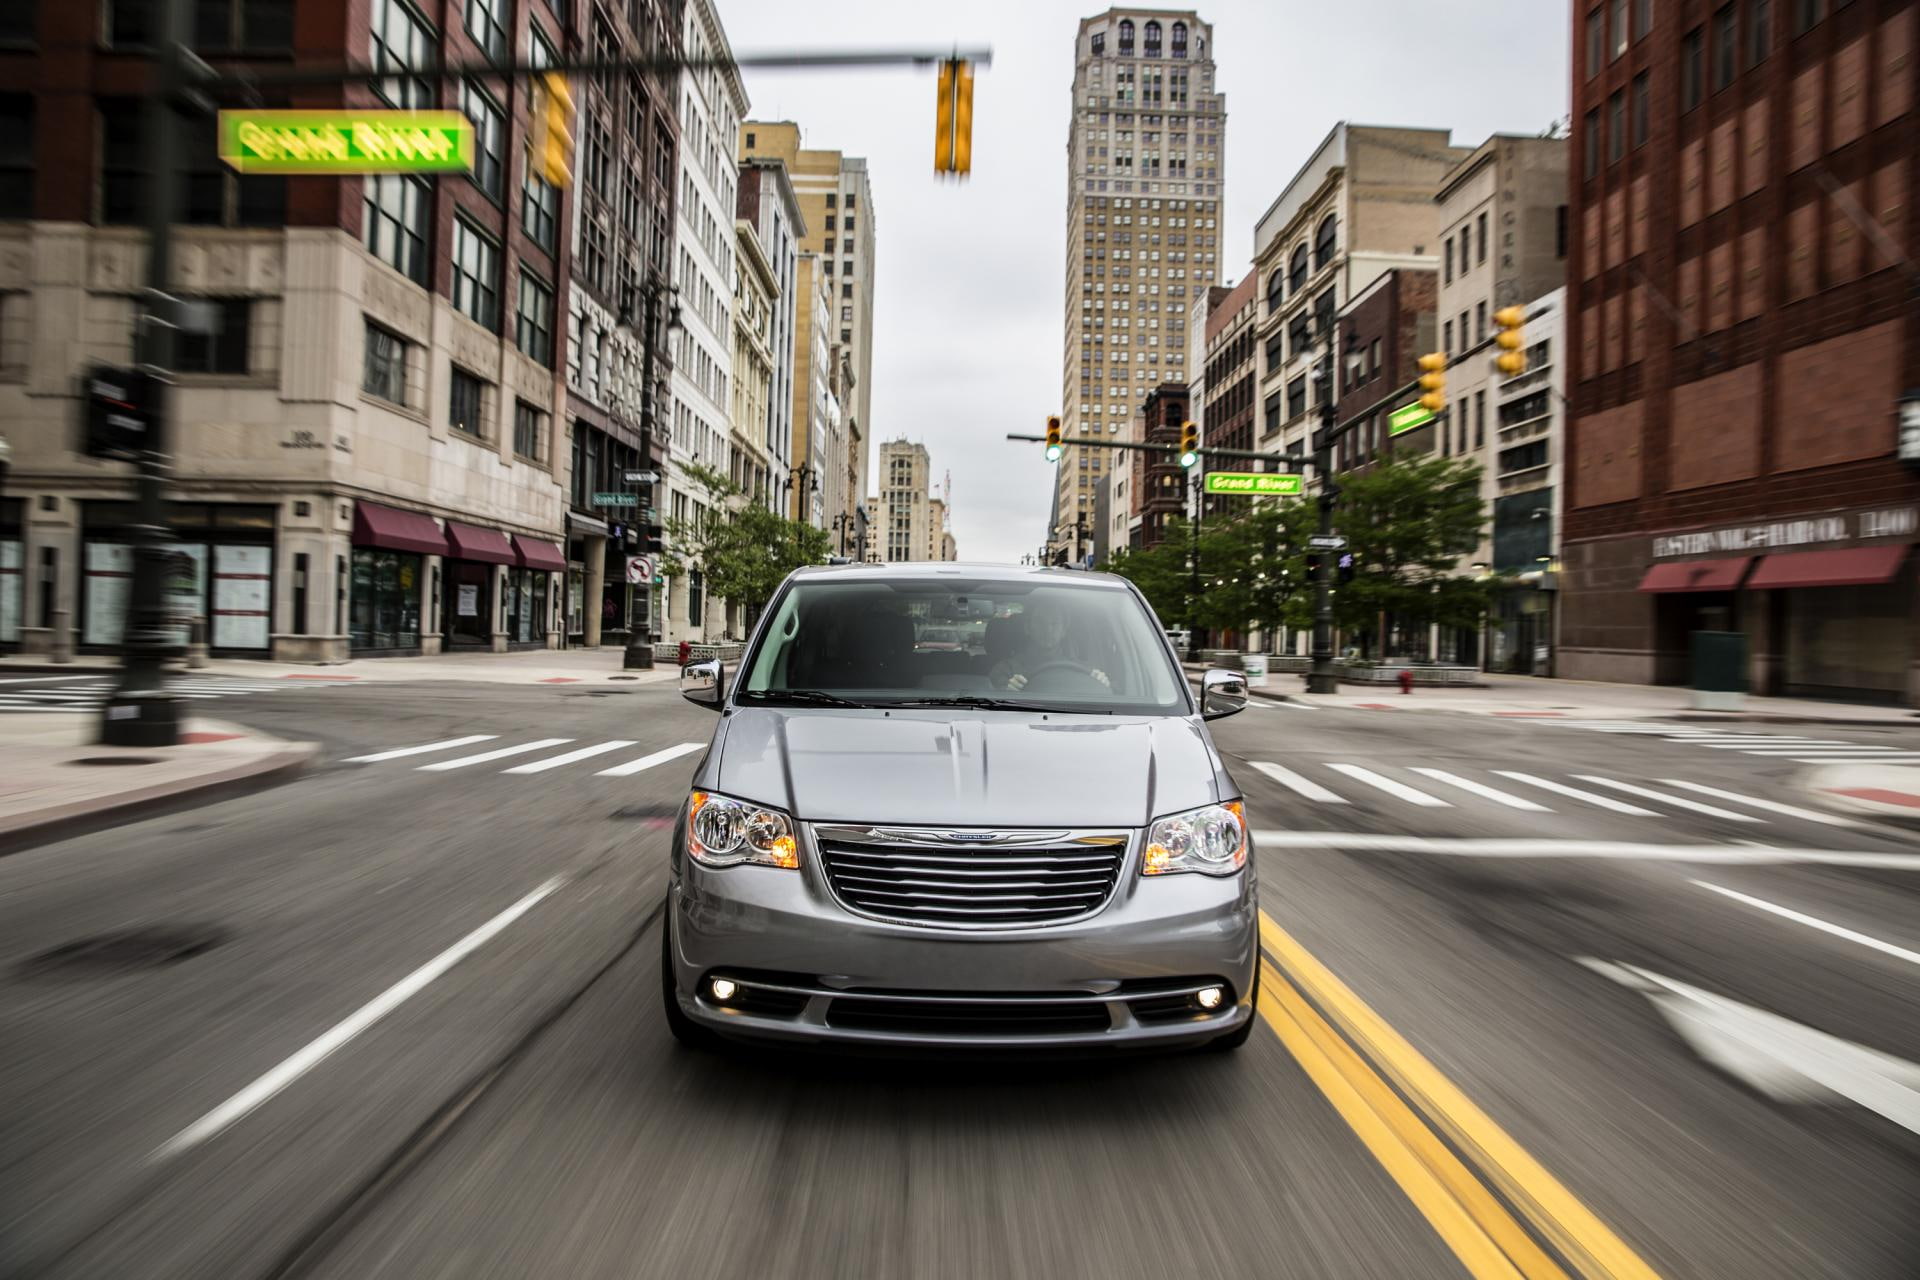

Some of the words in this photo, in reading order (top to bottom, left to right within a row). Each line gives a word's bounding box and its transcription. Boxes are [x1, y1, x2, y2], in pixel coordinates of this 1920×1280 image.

[239, 121, 348, 161] Grand
[352, 121, 453, 161] River
[1212, 476, 1254, 489] Grand
[1256, 478, 1296, 490] River
